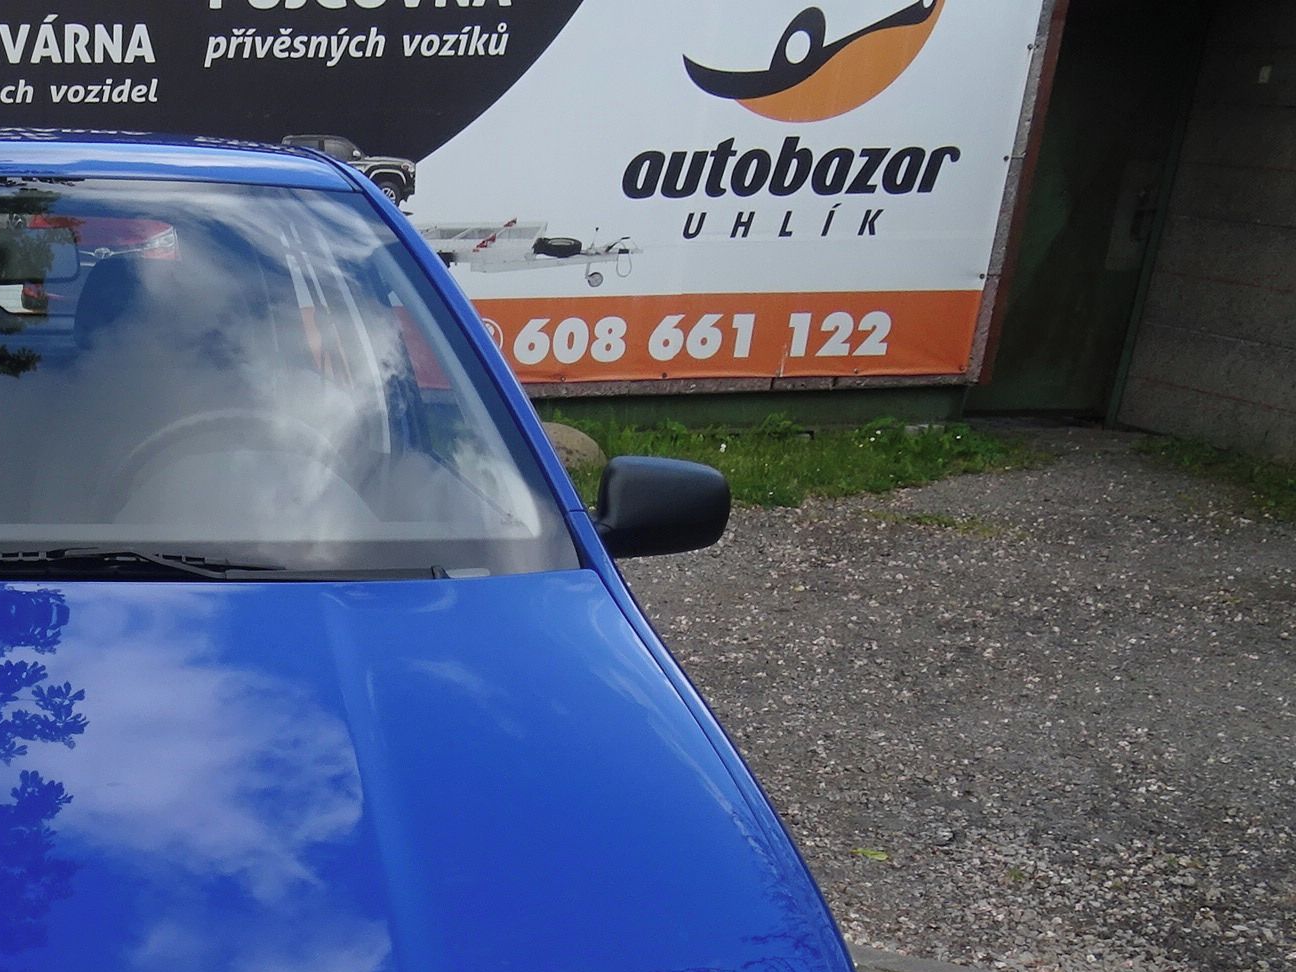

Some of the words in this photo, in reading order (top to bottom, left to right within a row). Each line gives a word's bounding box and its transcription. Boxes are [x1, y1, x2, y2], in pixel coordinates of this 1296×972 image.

[204, 27, 386, 68] přívěsných
[402, 22, 510, 57] vozíků
[50, 78, 159, 103] vozidel
[622, 136, 961, 199] autobazar
[682, 202, 885, 240] UHLÍK
[513, 316, 627, 365] 608
[648, 313, 756, 362] 661
[788, 311, 892, 357] 122
